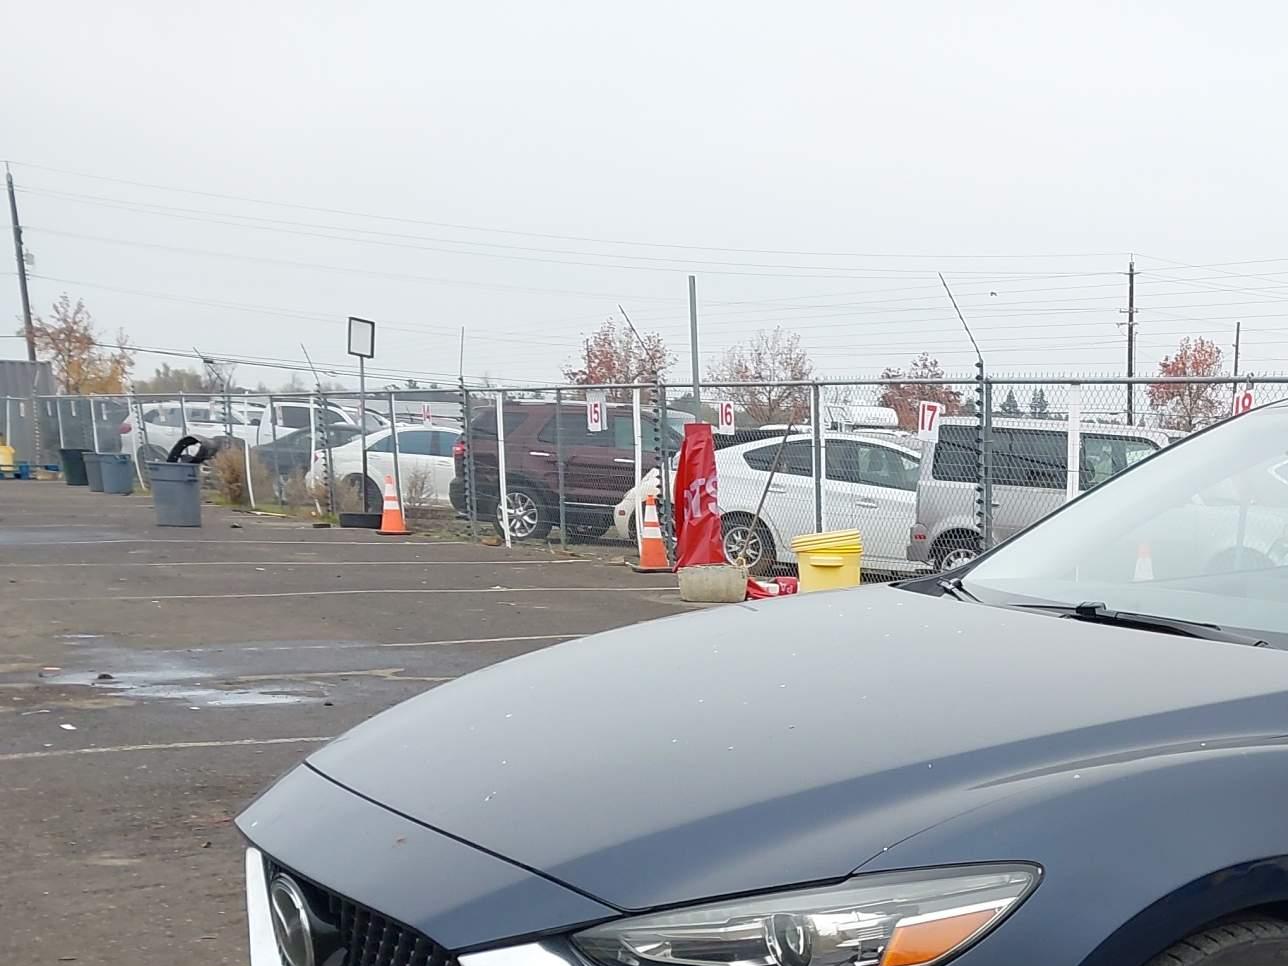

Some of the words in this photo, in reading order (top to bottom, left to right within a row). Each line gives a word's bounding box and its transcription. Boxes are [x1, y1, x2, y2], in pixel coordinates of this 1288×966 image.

[590, 402, 601, 423] 15
[720, 402, 733, 426] 16
[921, 404, 938, 431] 17
